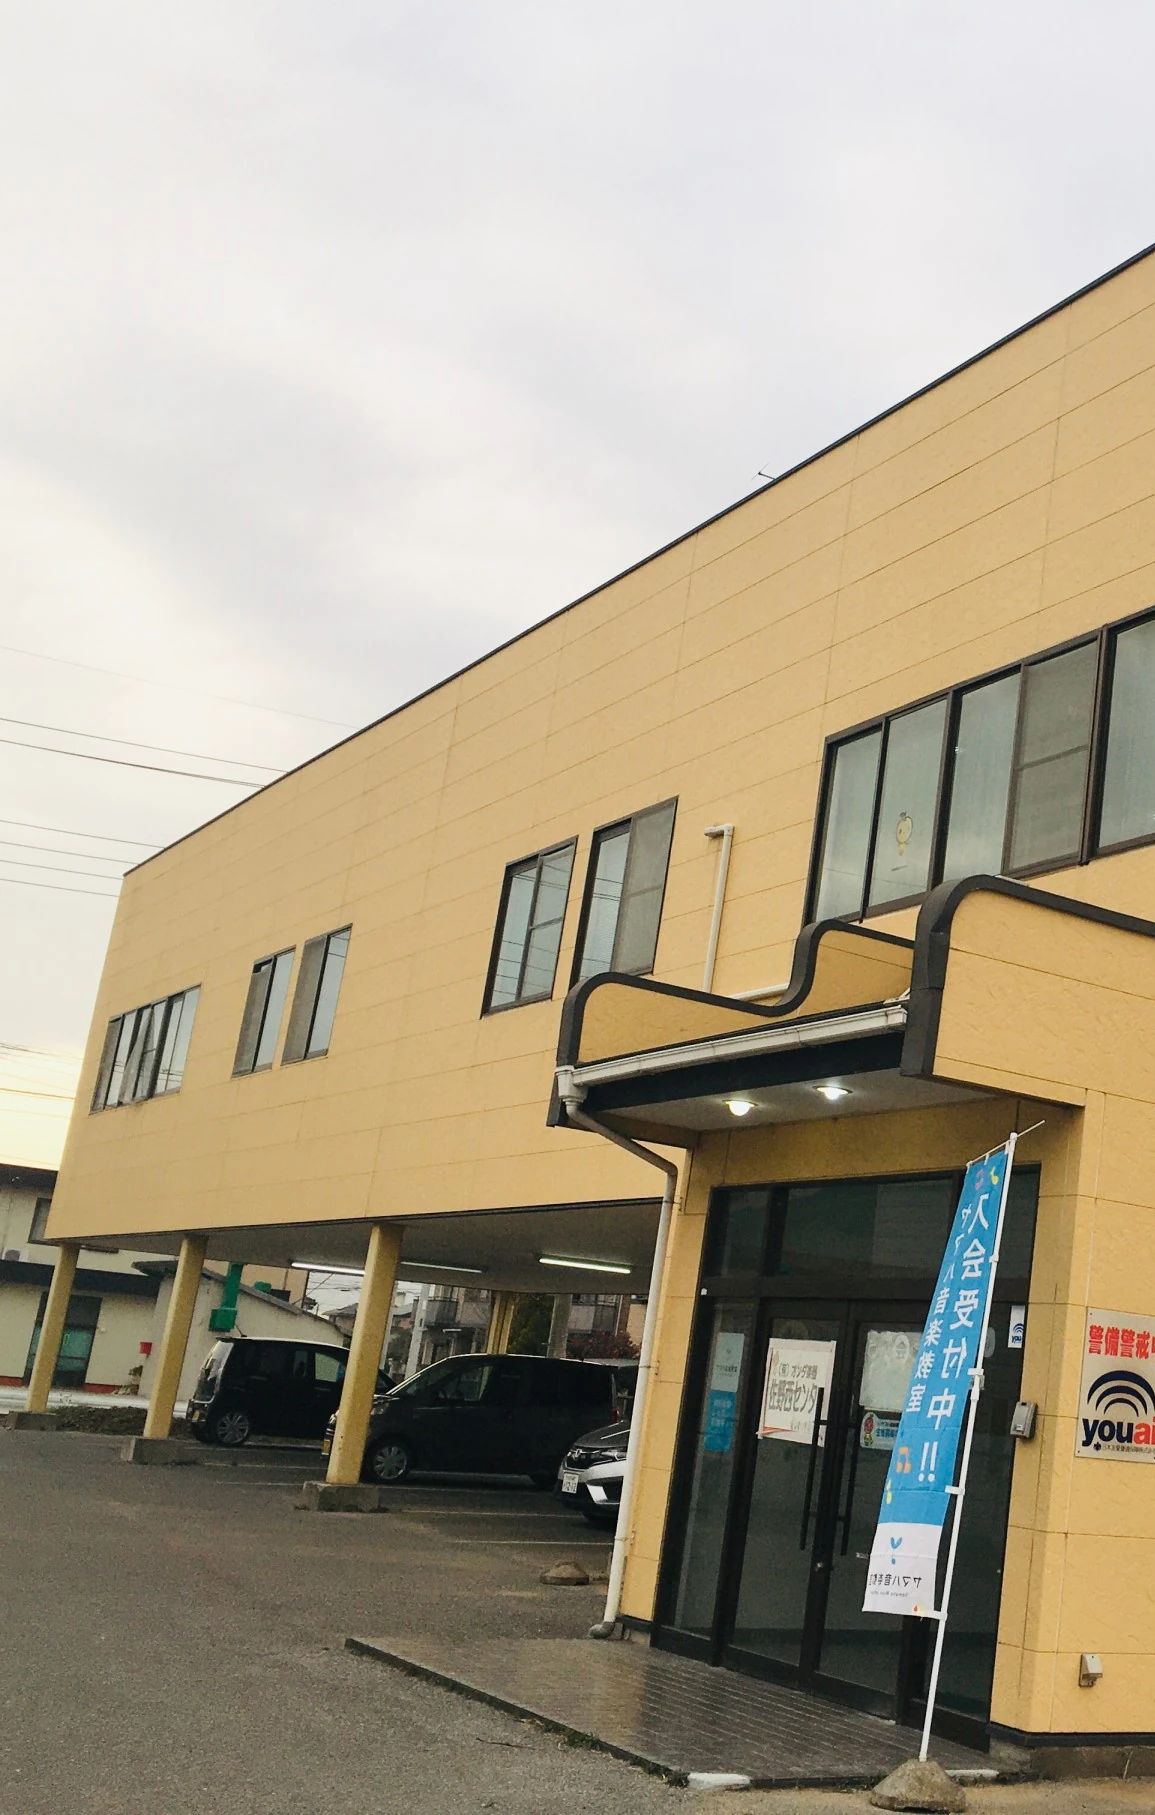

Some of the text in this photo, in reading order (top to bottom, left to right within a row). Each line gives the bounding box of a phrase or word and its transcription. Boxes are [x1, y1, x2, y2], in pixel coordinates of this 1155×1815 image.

[1011, 1335, 1022, 1344] you
[768, 1379, 818, 1414] 佐野西センタ
